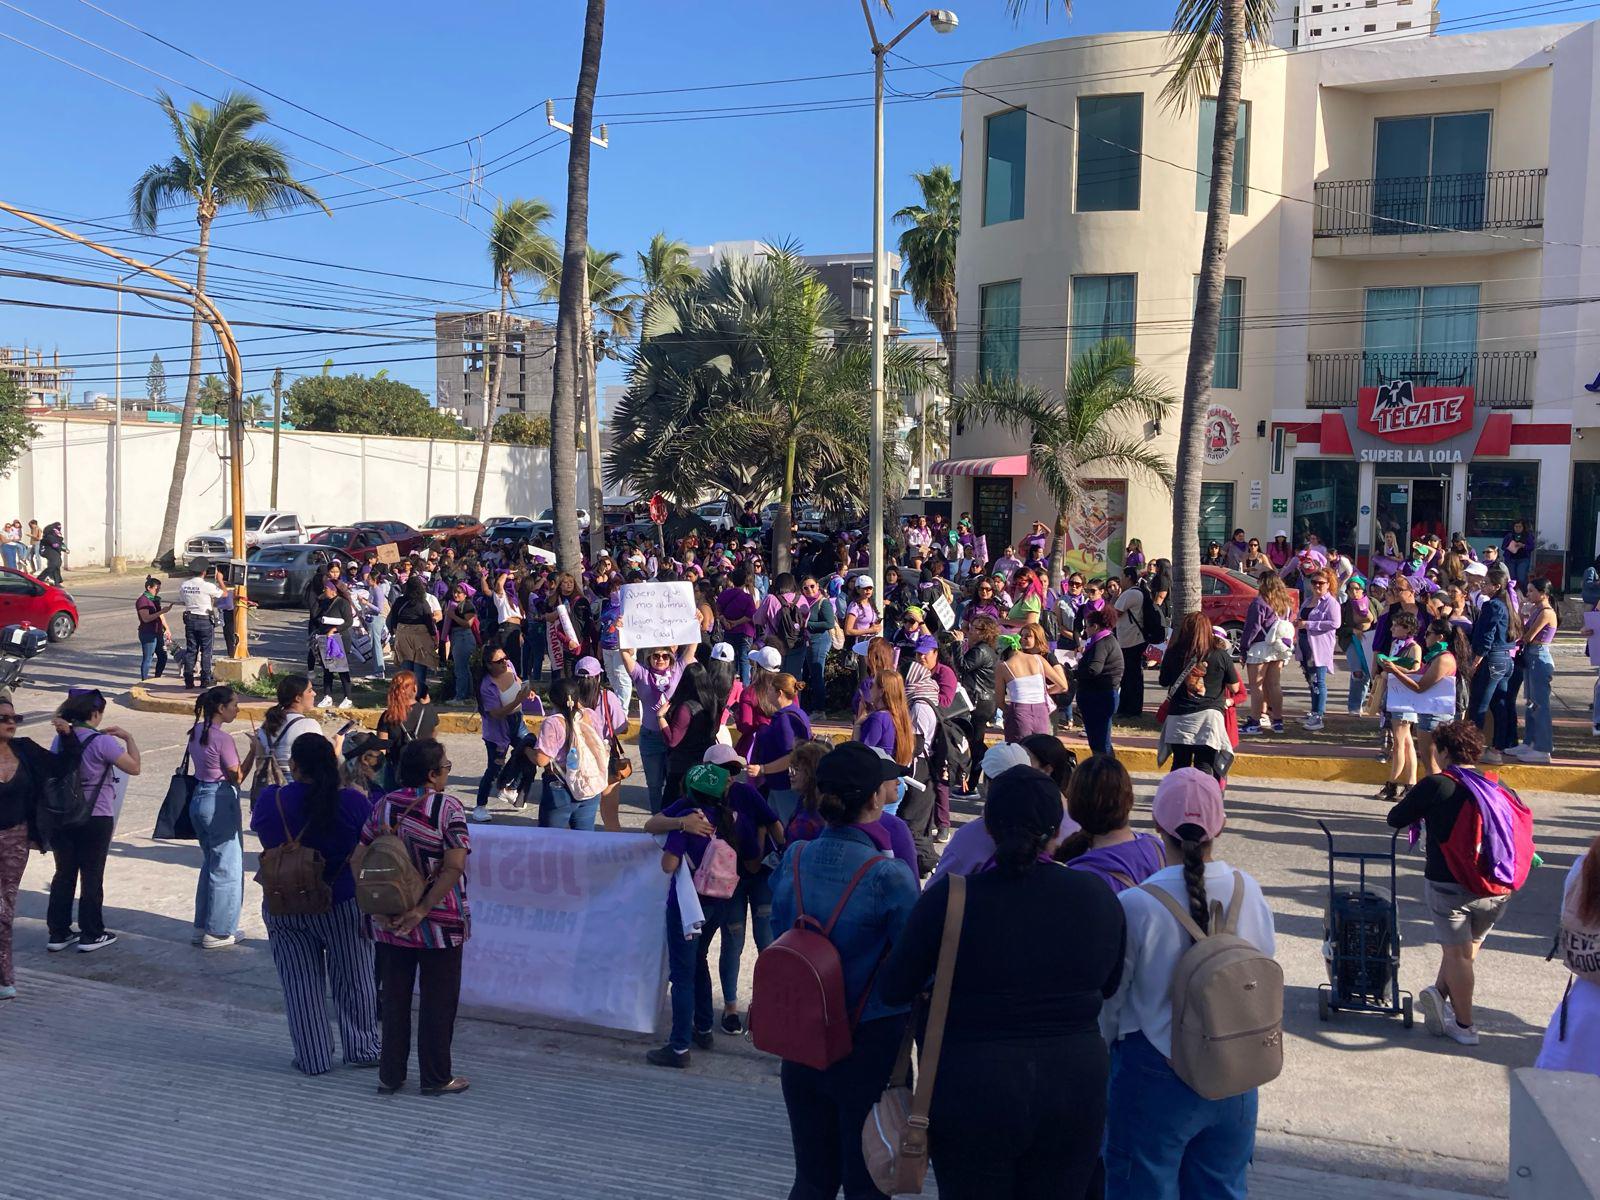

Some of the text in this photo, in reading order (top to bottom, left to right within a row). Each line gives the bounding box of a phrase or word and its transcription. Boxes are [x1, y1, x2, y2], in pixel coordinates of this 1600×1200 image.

[1377, 399, 1462, 432] TECATE
[1207, 447, 1231, 460] natural
[1360, 449, 1463, 462] SUPER LA LOLA
[1456, 493, 1462, 501] 3
